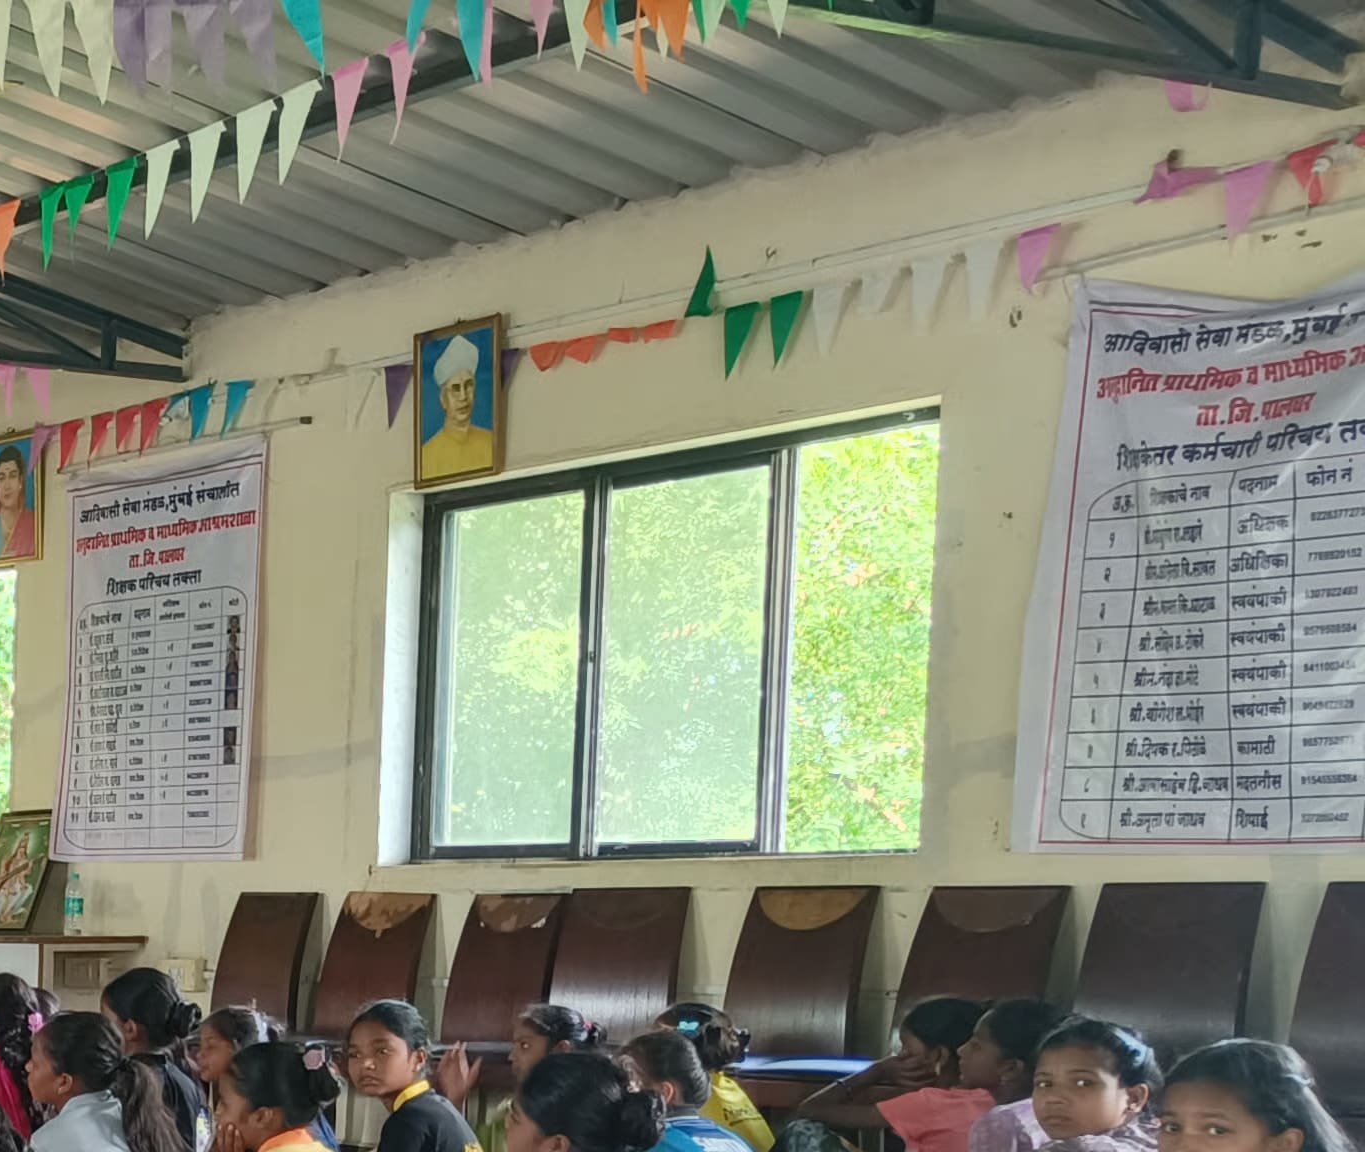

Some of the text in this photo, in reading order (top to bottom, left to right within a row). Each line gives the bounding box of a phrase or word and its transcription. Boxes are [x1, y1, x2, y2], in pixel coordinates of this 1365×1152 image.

[1196, 324, 1233, 351] सेवा
[1163, 367, 1242, 392] प्राथमिक
[1247, 365, 1259, 385] व
[1262, 349, 1348, 383] माध्यमिक
[1181, 431, 1262, 462] कर्मचारी
